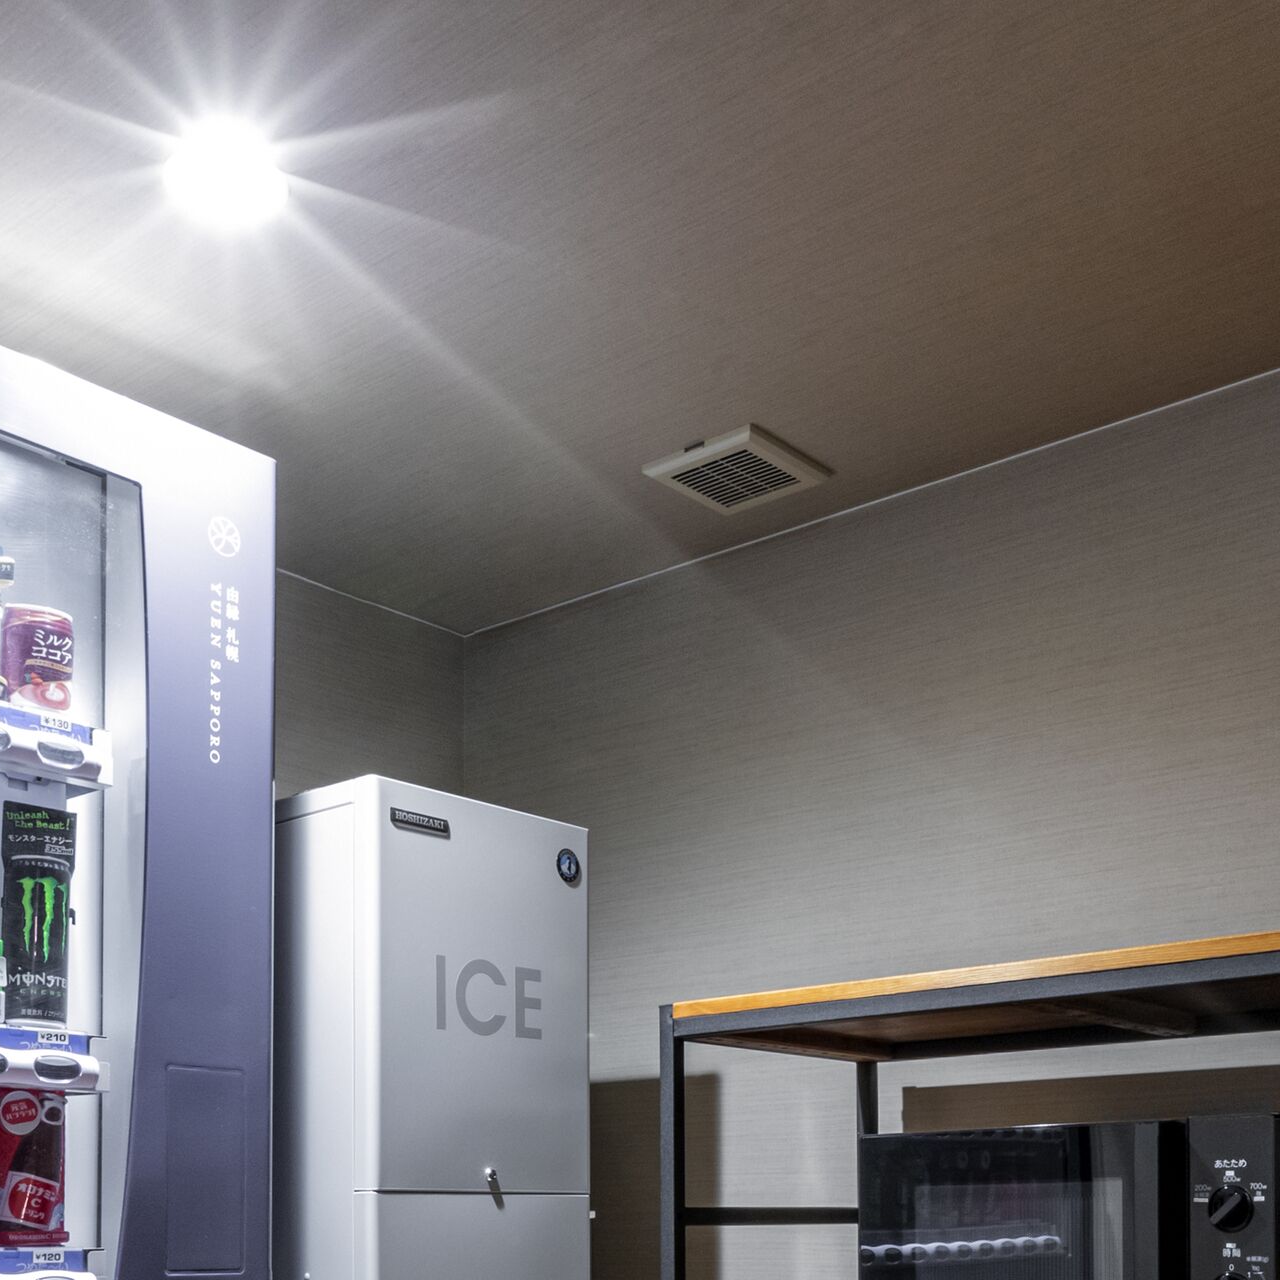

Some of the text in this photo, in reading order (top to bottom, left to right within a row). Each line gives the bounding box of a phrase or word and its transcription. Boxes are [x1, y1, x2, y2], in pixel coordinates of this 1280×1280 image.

[33, 630, 73, 650] ミルク
[32, 646, 73, 666] ココア
[209, 582, 222, 765] YUEN SAPPORO
[6, 811, 50, 820] Unleash
[395, 810, 445, 830] HOSHIZAKI
[15, 818, 70, 831] the Beast!
[8, 833, 73, 845] モンスターエナジー
[8, 972, 67, 988] MONSTE
[435, 954, 543, 1041] ICE
[1214, 1158, 1247, 1169] あたため
[31, 1198, 42, 1207] C
